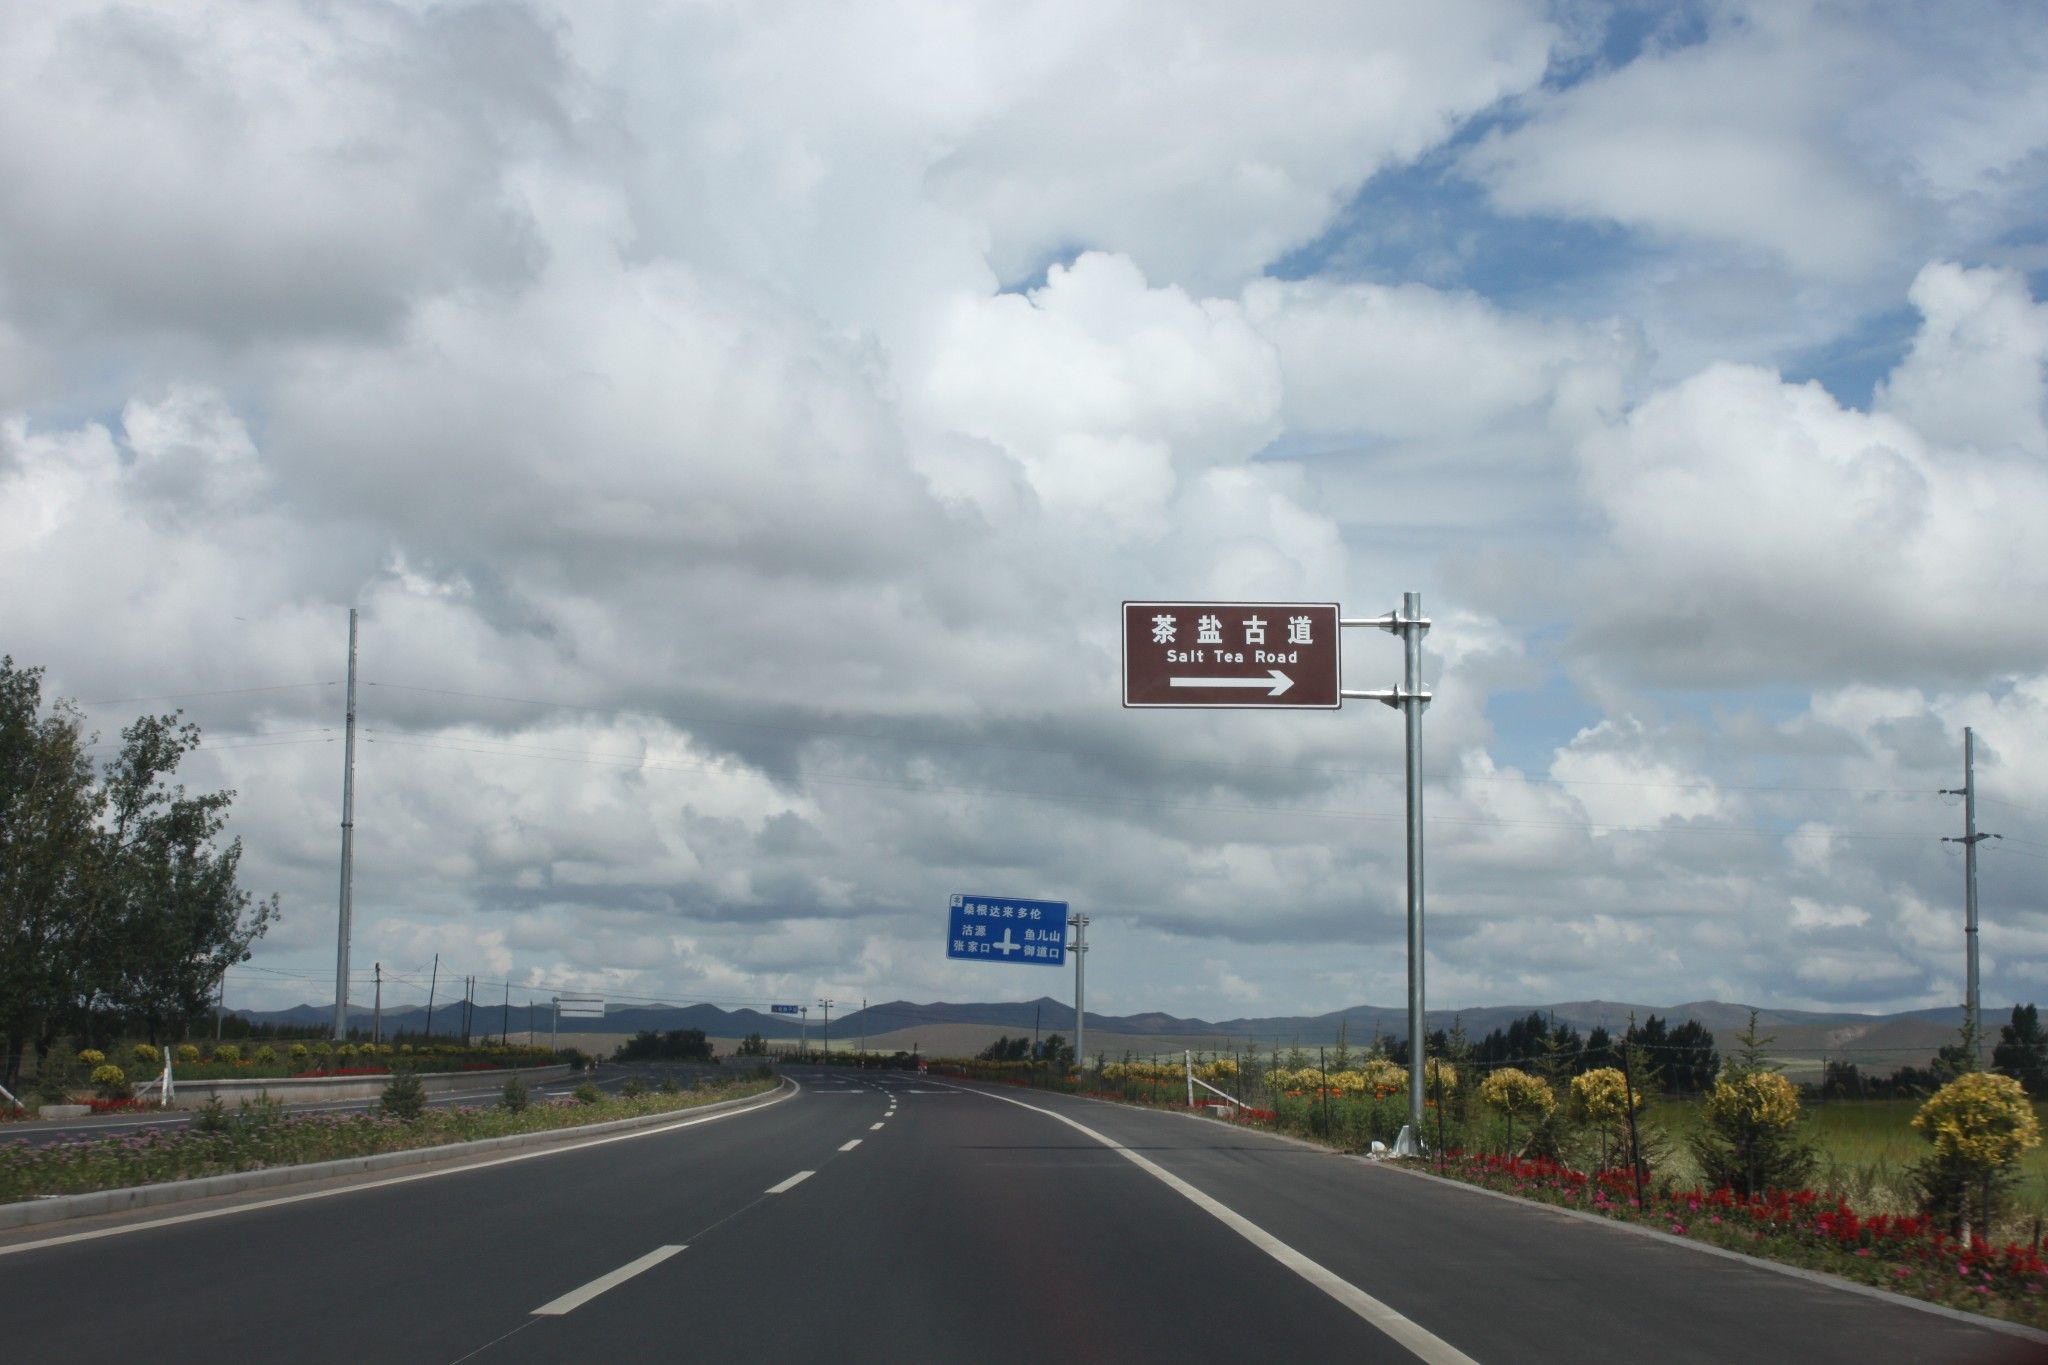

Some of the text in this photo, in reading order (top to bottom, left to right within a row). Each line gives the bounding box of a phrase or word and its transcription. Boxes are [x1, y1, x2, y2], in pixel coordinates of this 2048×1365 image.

[1151, 614, 1314, 645] 茶盐古道
[1166, 649, 1298, 664] Salt Tea Road
[961, 924, 987, 937] 沽源
[1023, 928, 1061, 943] 鱼儿山
[953, 939, 990, 954] 张家口
[1023, 945, 1060, 959] 御道口
